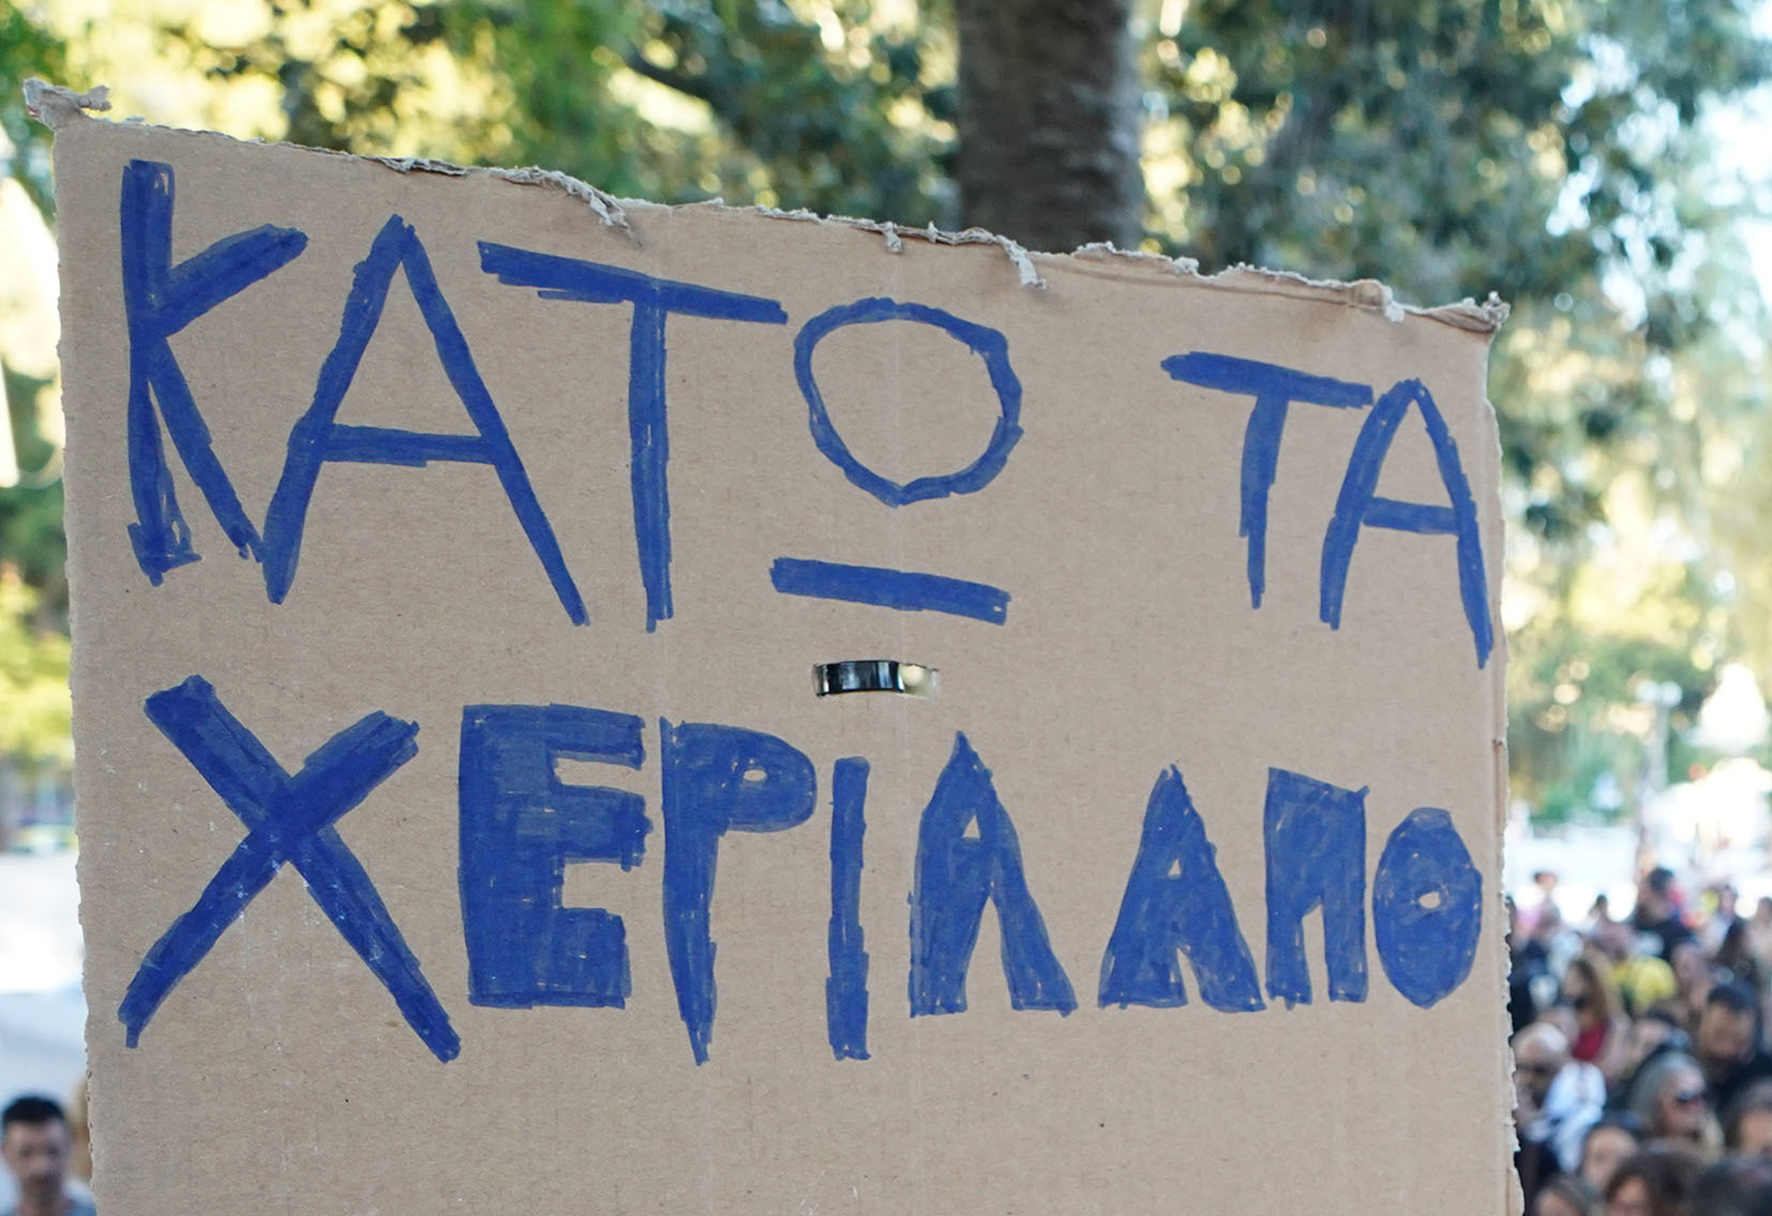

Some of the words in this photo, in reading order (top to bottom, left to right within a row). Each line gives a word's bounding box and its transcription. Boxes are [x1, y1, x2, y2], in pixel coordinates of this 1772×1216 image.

[1160, 350, 1495, 669] ΤΑ
[116, 674, 1079, 1067] ΧΕΡΙΑ
[1096, 763, 1484, 1014] ΑΠΟ
